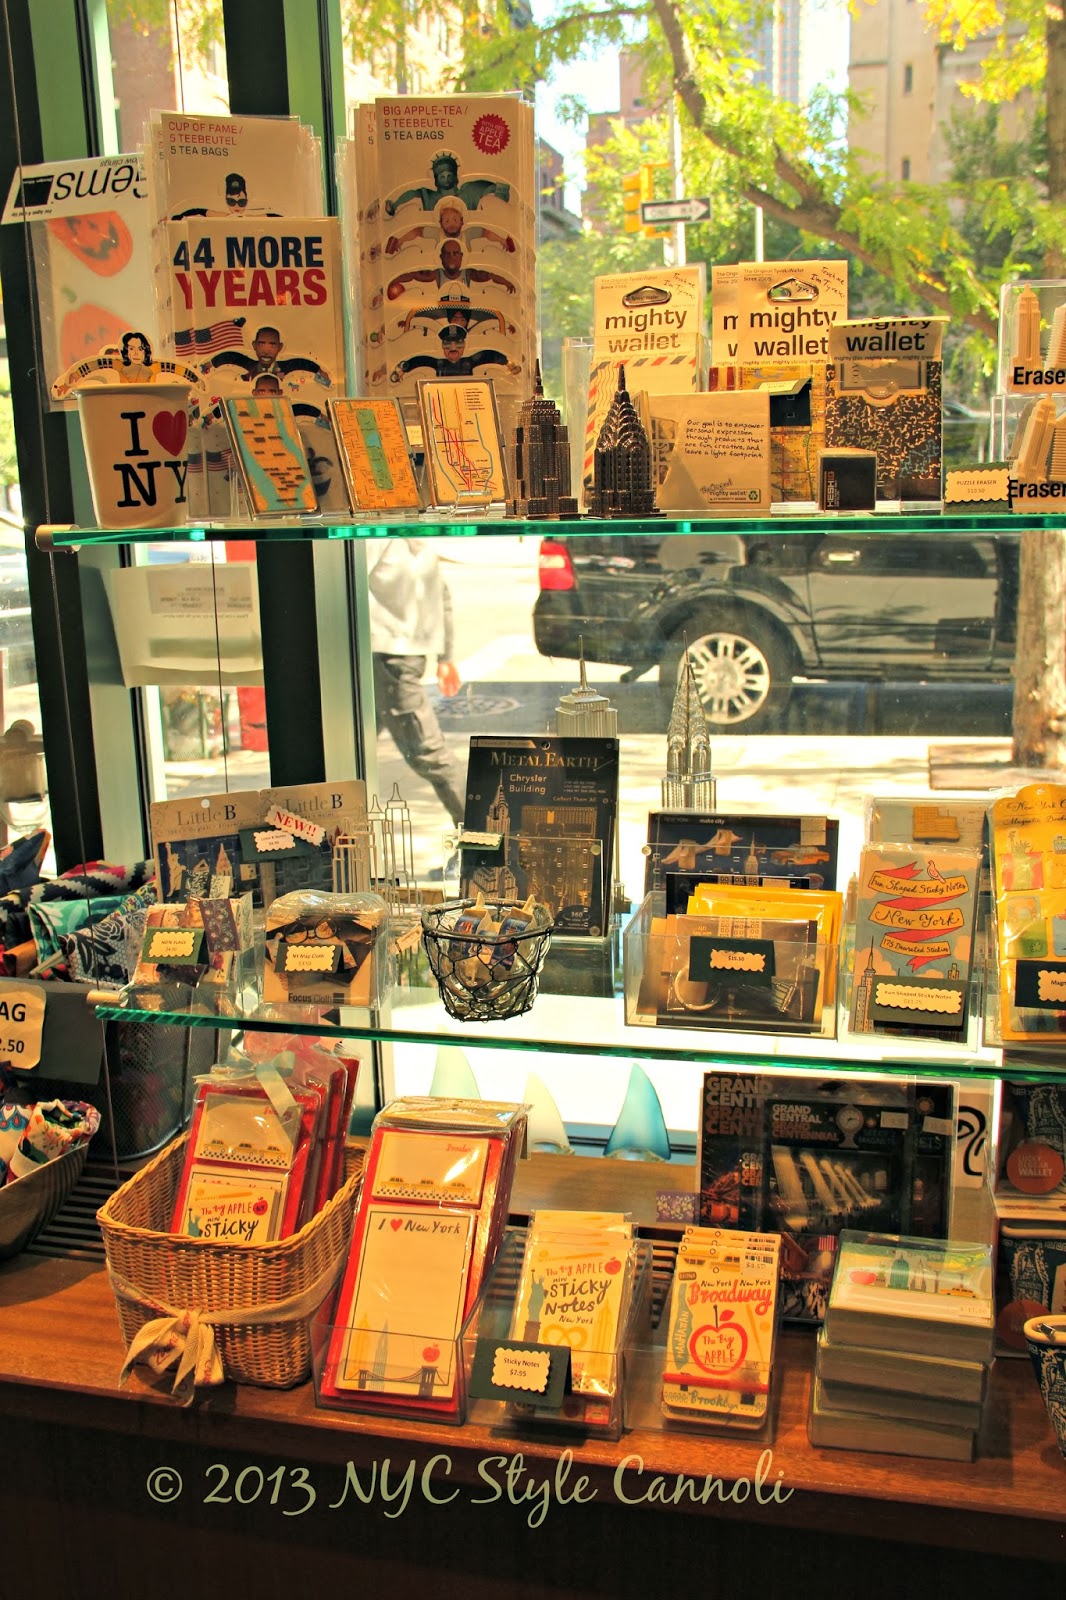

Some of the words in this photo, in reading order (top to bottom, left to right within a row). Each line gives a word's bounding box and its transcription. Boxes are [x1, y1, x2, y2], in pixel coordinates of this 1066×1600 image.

[384, 106, 400, 115] BIG
[168, 122, 190, 131] CUP
[192, 123, 206, 132] OF
[384, 119, 390, 128] 5
[393, 118, 453, 128] TEEBEUTEL
[170, 134, 176, 142] 5
[178, 134, 237, 146] TEEBEUTEL
[384, 132, 390, 140] 5
[394, 131, 413, 140] TEA
[416, 131, 444, 140] BAGS
[480, 127, 503, 139] APPLE
[478, 132, 501, 150] TEA
[170, 146, 176, 154] 5
[179, 146, 198, 155] TEA
[201, 146, 228, 156] BAGS
[226, 236, 324, 268] MORE
[606, 308, 688, 332] mighty
[750, 306, 836, 333] mighty
[608, 333, 680, 353] wallet
[754, 335, 828, 356] wallet
[846, 331, 925, 352] wallet
[702, 420, 715, 428] goal
[734, 422, 764, 430] empower
[120, 412, 149, 456] I
[686, 434, 712, 443] through
[715, 436, 744, 444] products
[711, 450, 727, 458] light
[490, 751, 542, 766] METAL
[545, 752, 598, 768] EARTH
[510, 774, 548, 784] Chrysler
[509, 785, 546, 794] Building
[286, 796, 328, 812] Little
[332, 794, 342, 808] B
[1012, 802, 1034, 811] New
[177, 808, 221, 826] Little
[224, 805, 236, 820] B
[274, 811, 316, 836] NEW!!
[871, 876, 884, 888] Fun
[886, 880, 917, 894] Shaped
[919, 884, 944, 895] Sticky
[946, 882, 966, 892] Notes
[875, 910, 915, 926] New
[919, 912, 960, 928] York
[883, 939, 894, 948] 175
[288, 992, 312, 1002] Focus
[314, 993, 332, 1004] Cloth
[706, 1077, 773, 1094] GRAND
[772, 1104, 811, 1114] GRAND
[772, 1113, 822, 1124] CENTRAL
[772, 1122, 810, 1130] GRAND
[772, 1130, 839, 1141] CENTENNIAL
[1018, 1168, 1053, 1176] WALLET
[202, 1208, 212, 1216] The
[228, 1202, 252, 1214] APPLE
[378, 1218, 387, 1230] I
[404, 1218, 431, 1232] New
[432, 1219, 462, 1234] York
[546, 1268, 558, 1276] The
[576, 1262, 603, 1274] APPLE
[687, 1280, 772, 1316] Broadway
[545, 1297, 595, 1315] Notes
[576, 1316, 593, 1324] York
[702, 1336, 716, 1344] The
[717, 1334, 734, 1349] Big
[504, 1358, 522, 1366] Sticky
[522, 1360, 540, 1368] Notes
[705, 1349, 735, 1364] APPLE
[688, 1390, 738, 1412] Brooklyn
